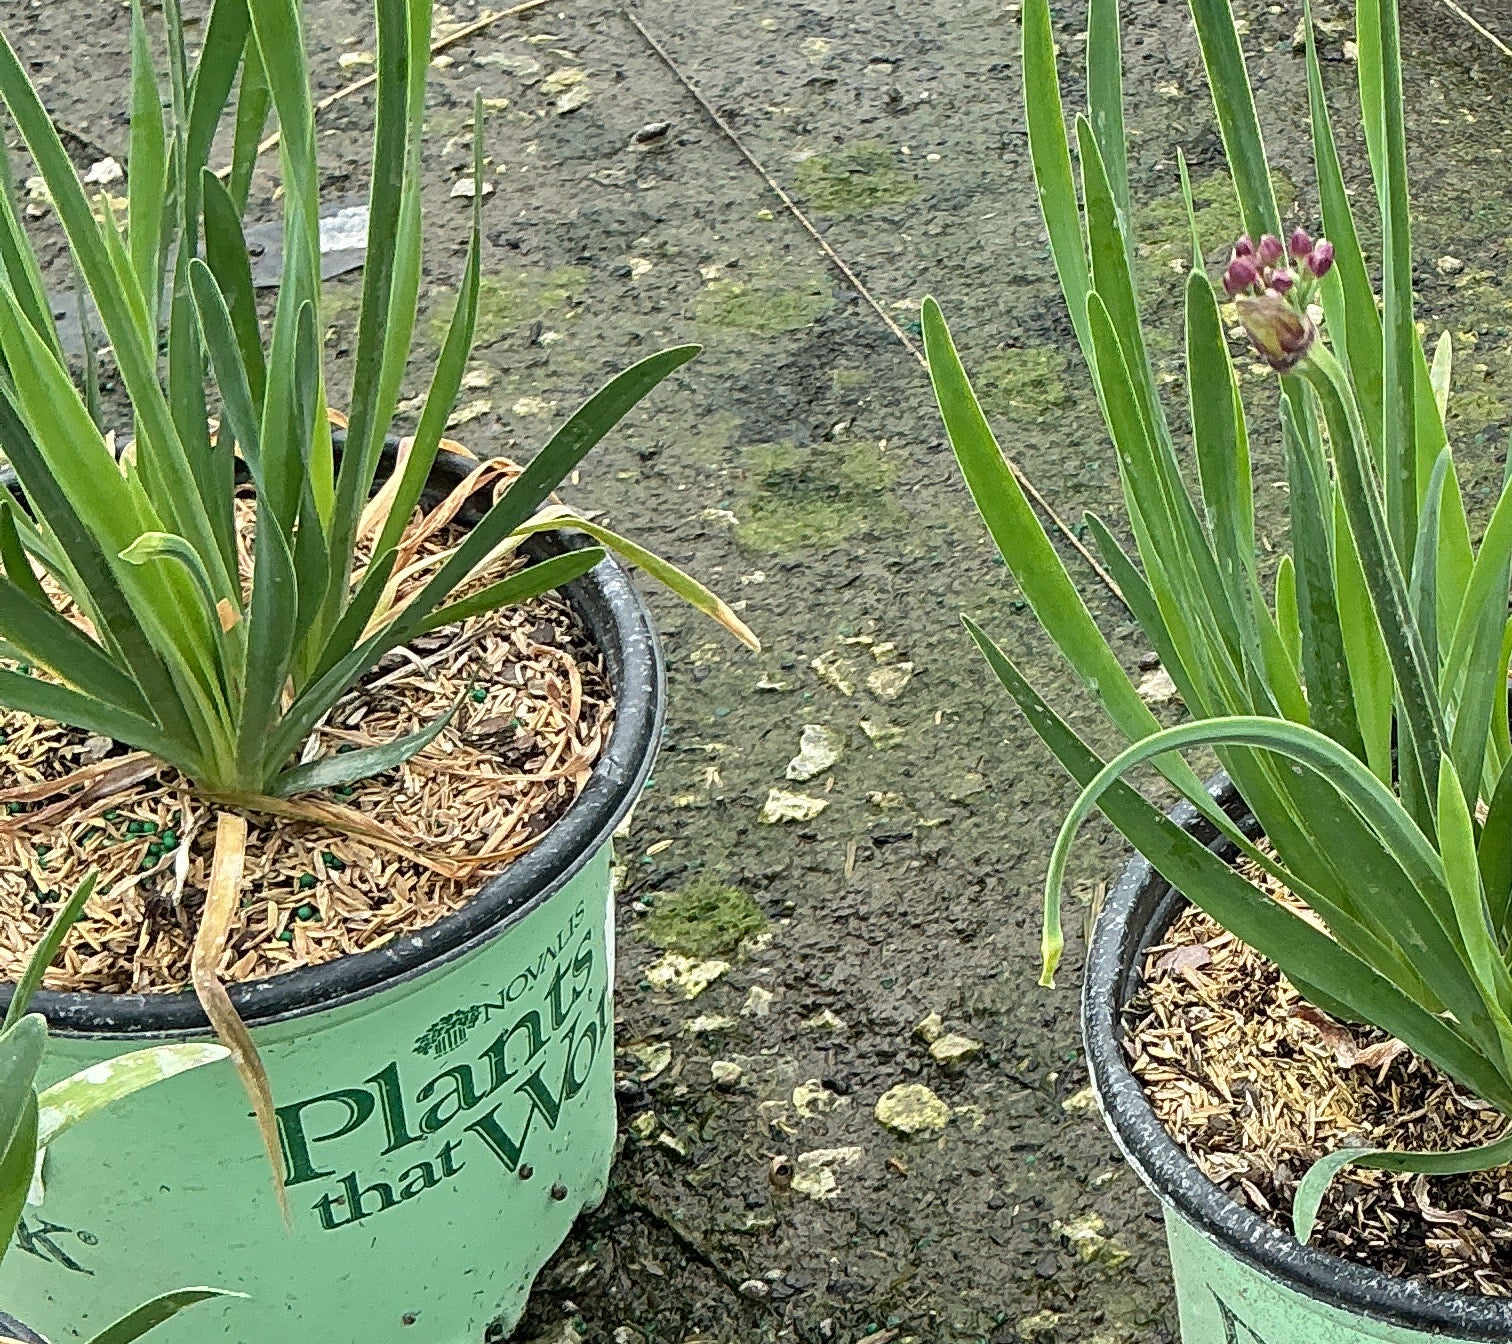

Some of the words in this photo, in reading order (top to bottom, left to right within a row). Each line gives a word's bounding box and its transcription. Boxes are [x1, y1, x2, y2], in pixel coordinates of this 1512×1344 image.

[249, 927, 594, 1187] Plants
[483, 899, 585, 1025] NOVALIS
[310, 1135, 467, 1232] that
[463, 985, 609, 1174] Wor
